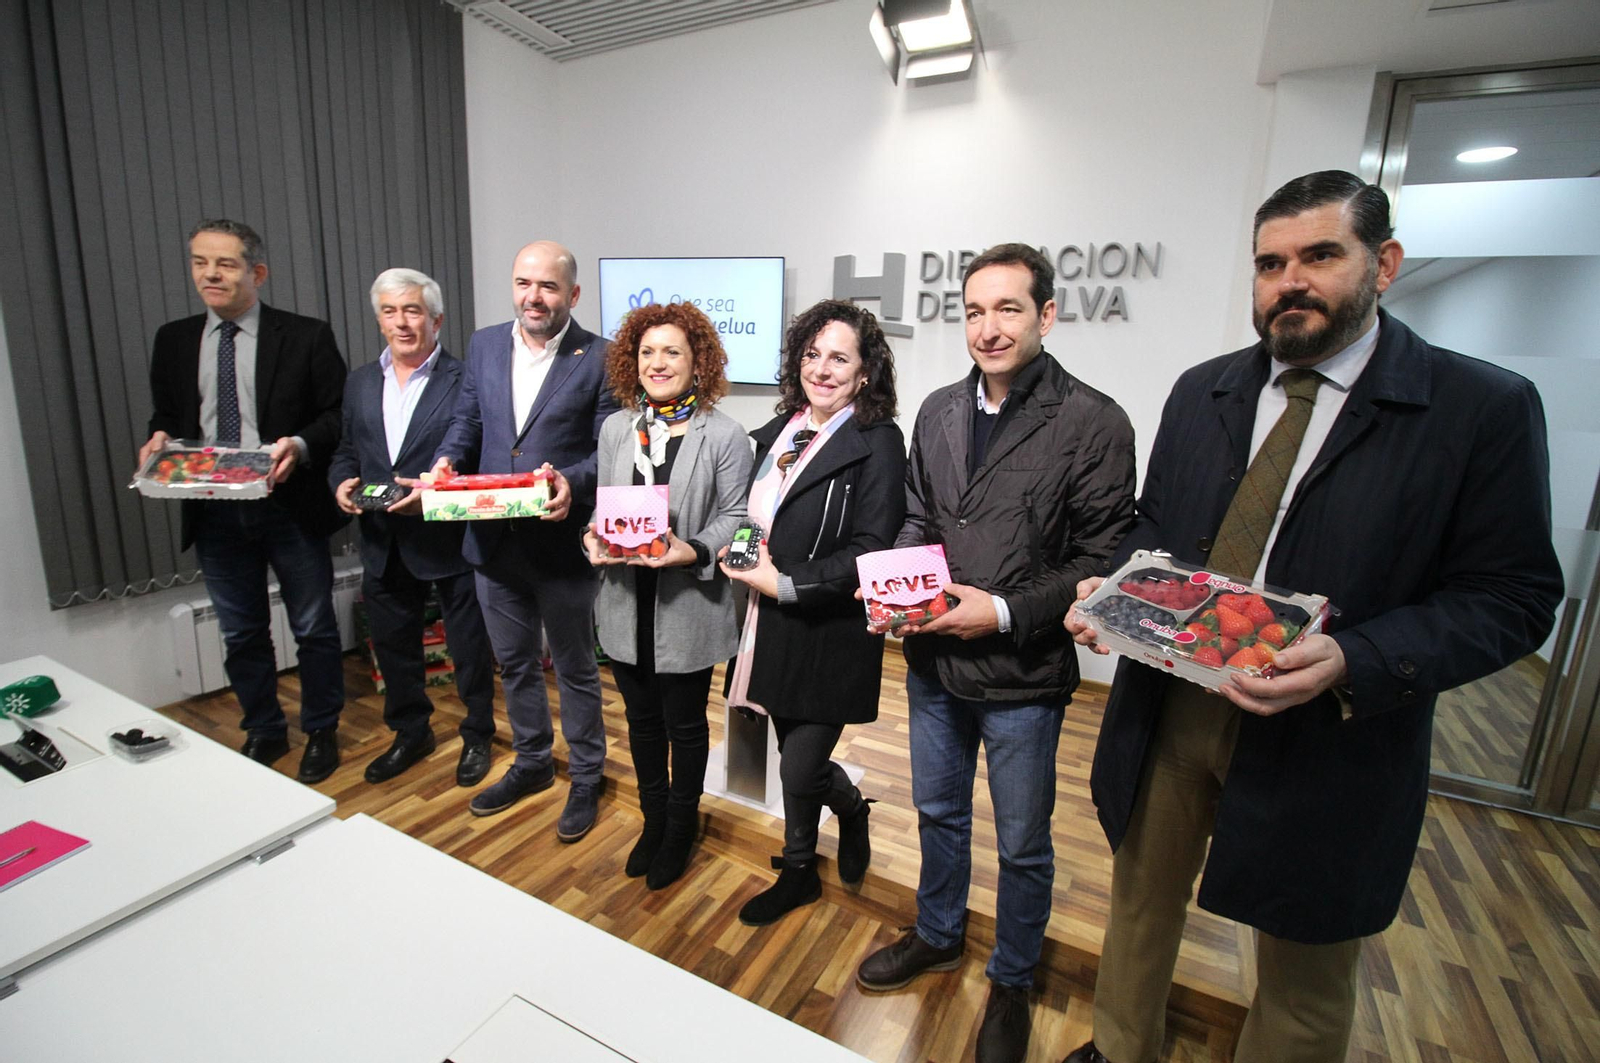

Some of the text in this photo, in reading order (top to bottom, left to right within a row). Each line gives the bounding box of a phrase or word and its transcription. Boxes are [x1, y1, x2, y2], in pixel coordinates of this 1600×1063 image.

[920, 242, 1162, 284] DIPCION
[706, 298, 735, 312] sea
[916, 289, 961, 322] DE
[604, 516, 657, 535] LOVE
[871, 573, 940, 597] LOVE
[1207, 578, 1246, 593] Onuba
[1139, 618, 1178, 636] Onuba
